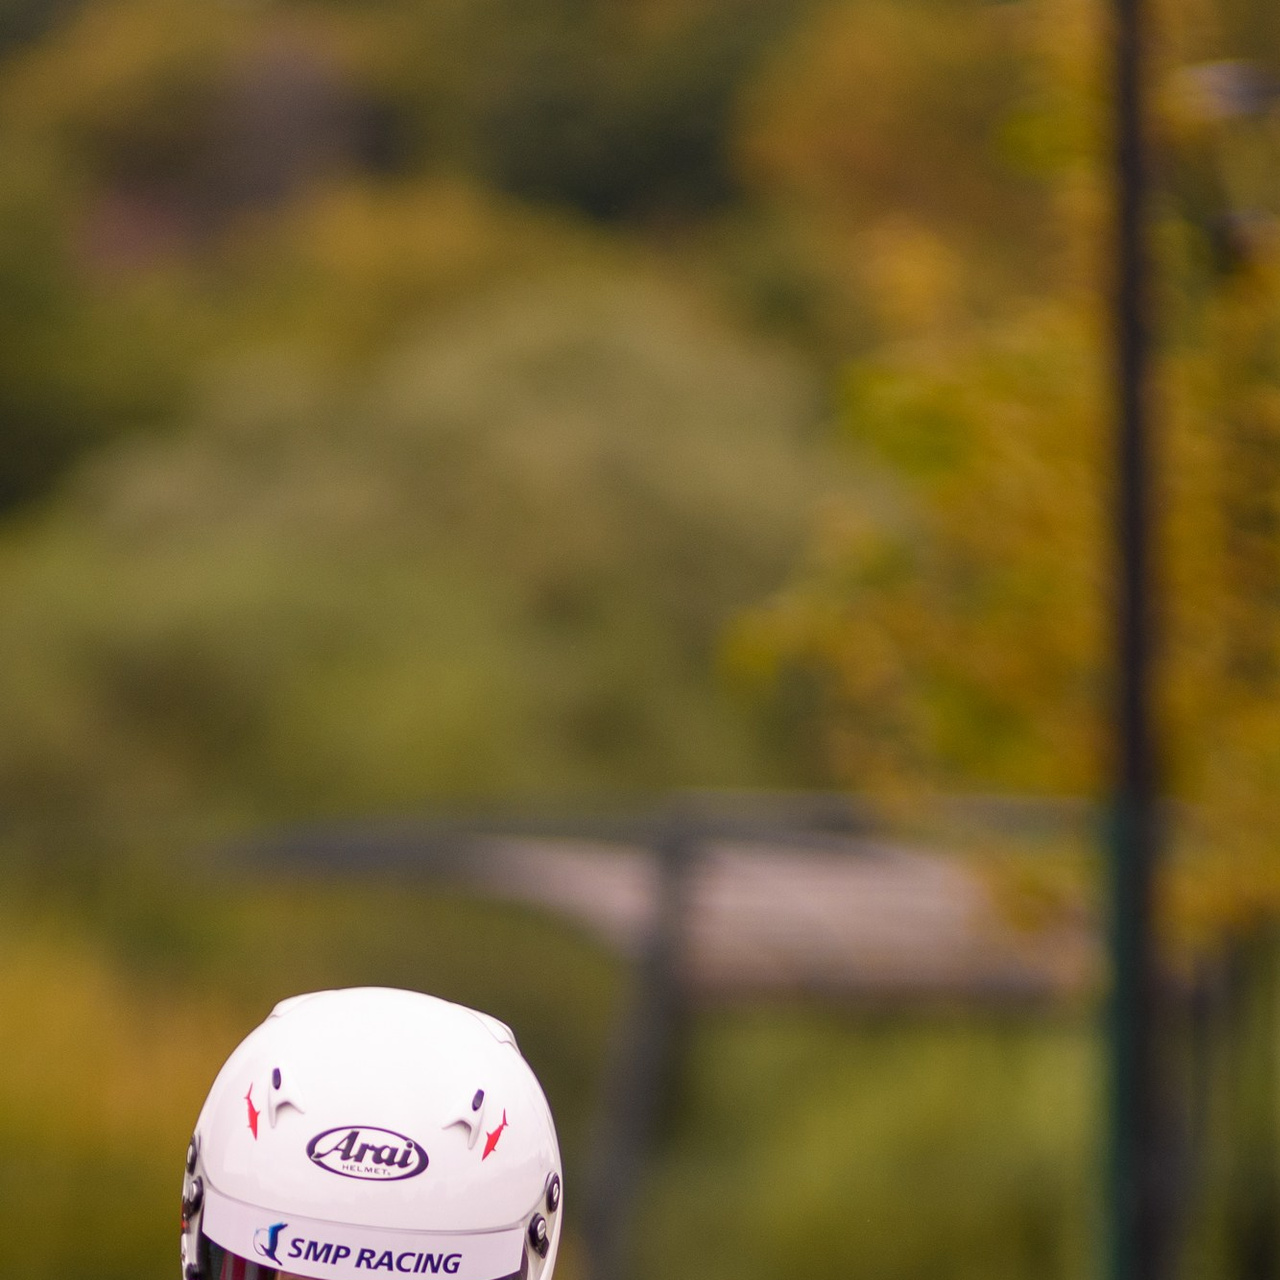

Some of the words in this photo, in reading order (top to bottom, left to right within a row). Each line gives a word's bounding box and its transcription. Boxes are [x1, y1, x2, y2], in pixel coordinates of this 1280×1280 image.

[311, 1130, 414, 1168] Arai
[287, 1237, 350, 1265] SMP
[355, 1248, 463, 1274] RACING
